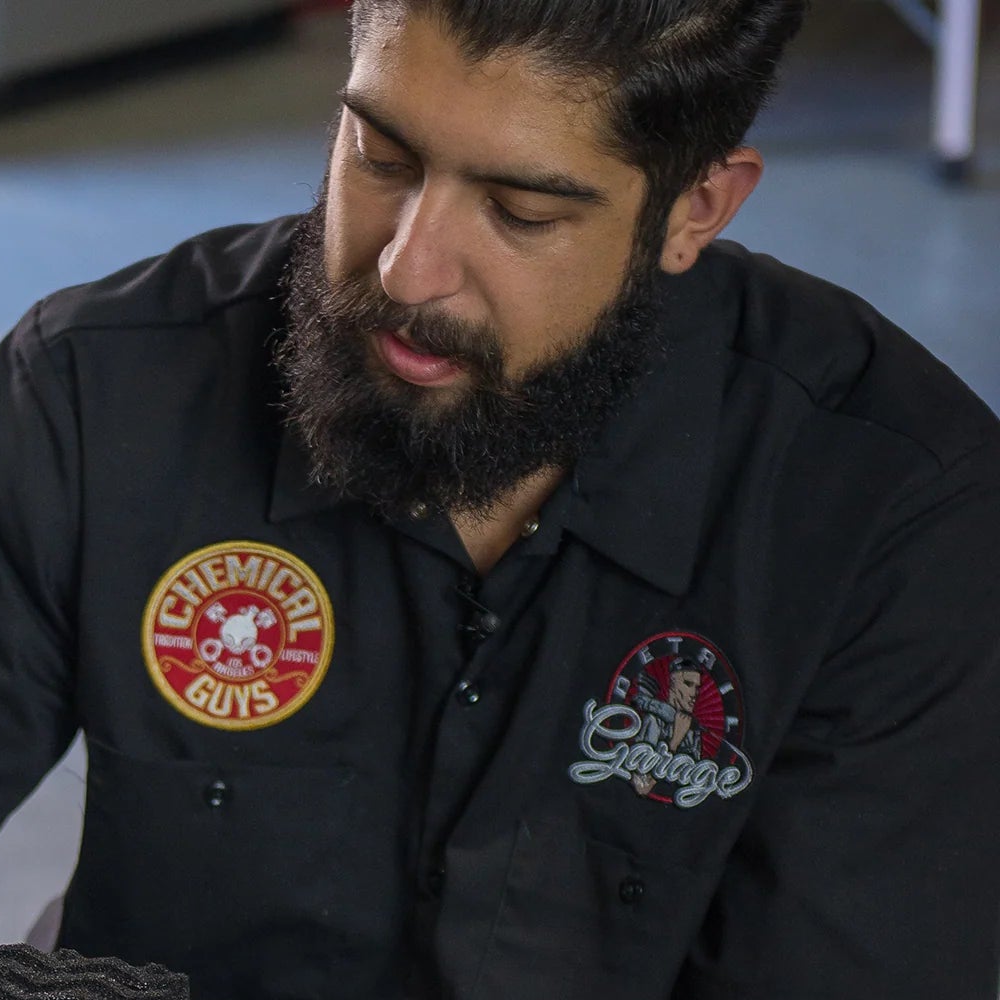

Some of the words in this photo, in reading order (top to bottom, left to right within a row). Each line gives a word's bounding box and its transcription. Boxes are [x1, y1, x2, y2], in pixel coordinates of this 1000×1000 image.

[158, 555, 322, 643] CHEMICAL
[184, 674, 280, 718] GUYS
[568, 698, 753, 808] Garage
